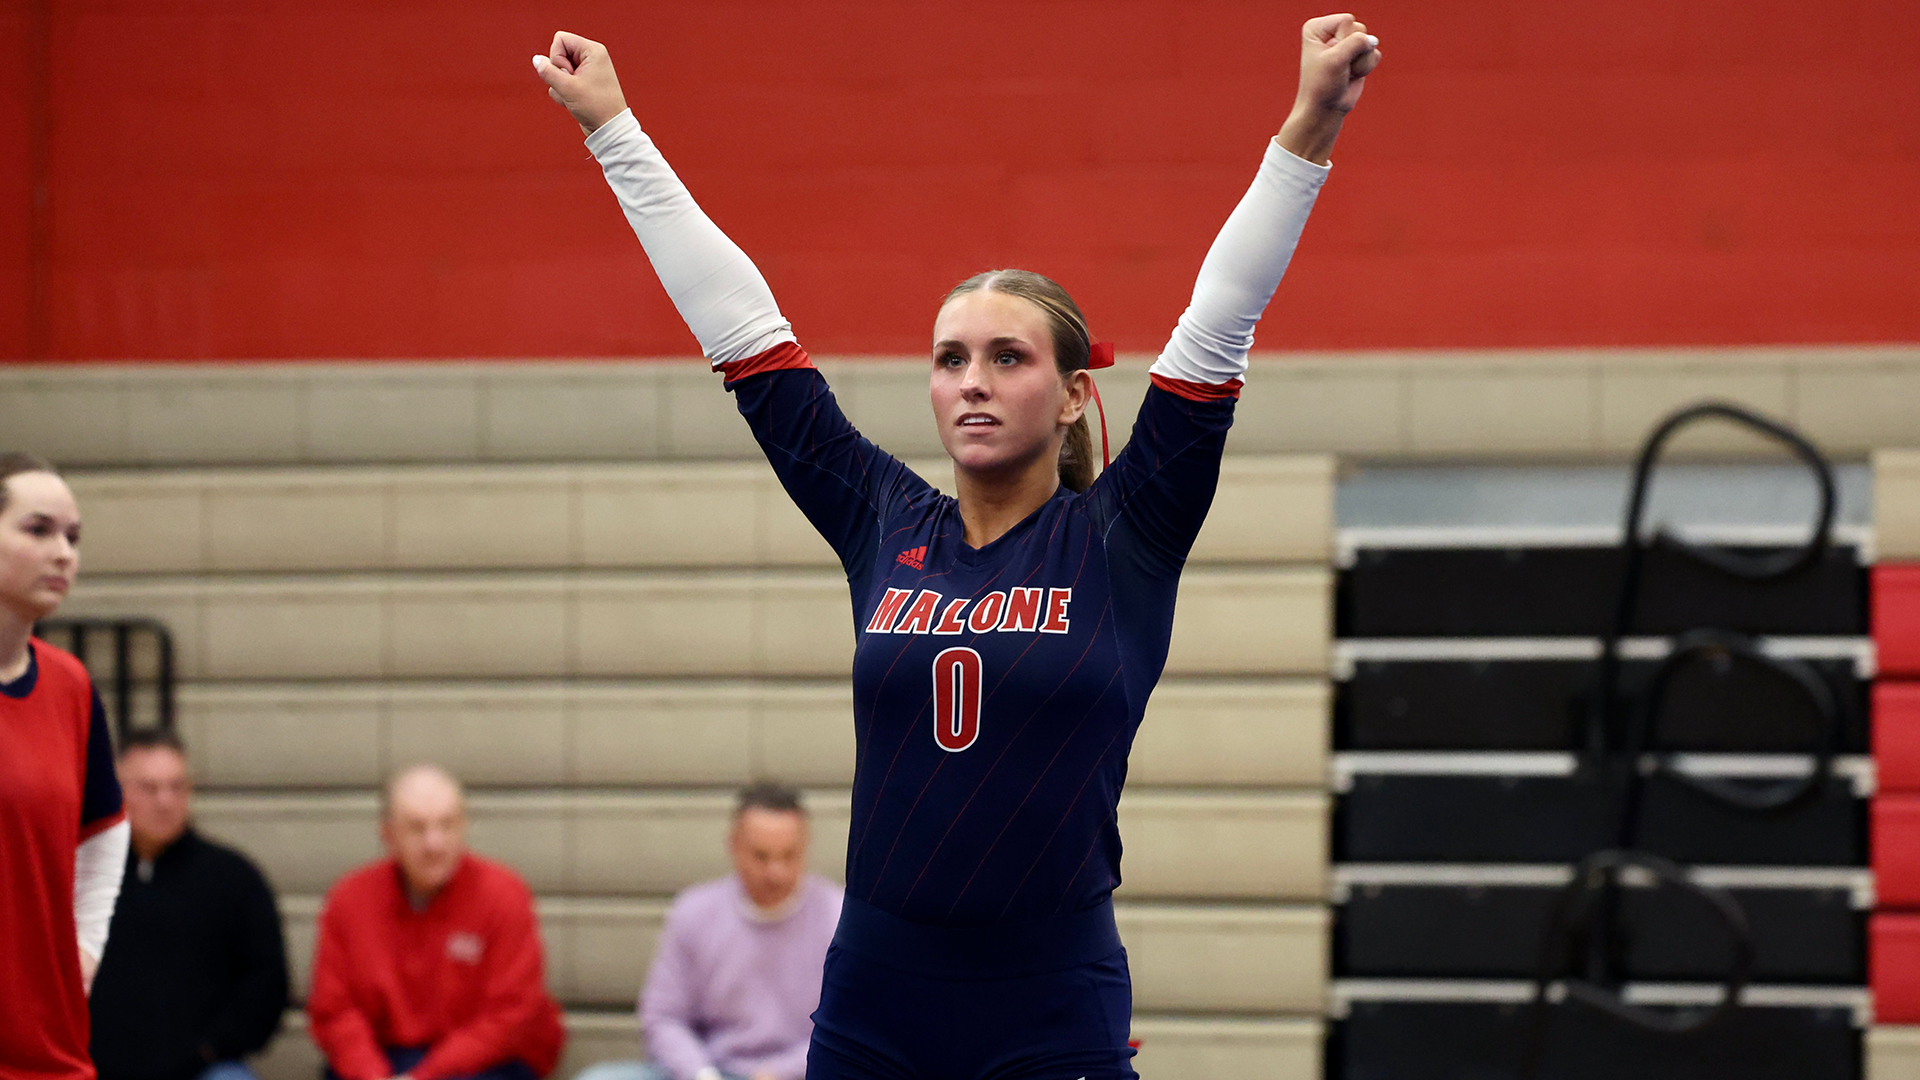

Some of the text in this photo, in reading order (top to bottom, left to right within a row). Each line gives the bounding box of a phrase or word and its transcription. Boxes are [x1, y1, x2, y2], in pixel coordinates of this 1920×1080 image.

[896, 554, 924, 571] adidas
[866, 587, 1072, 634] MALONE
[932, 646, 983, 753] 0
